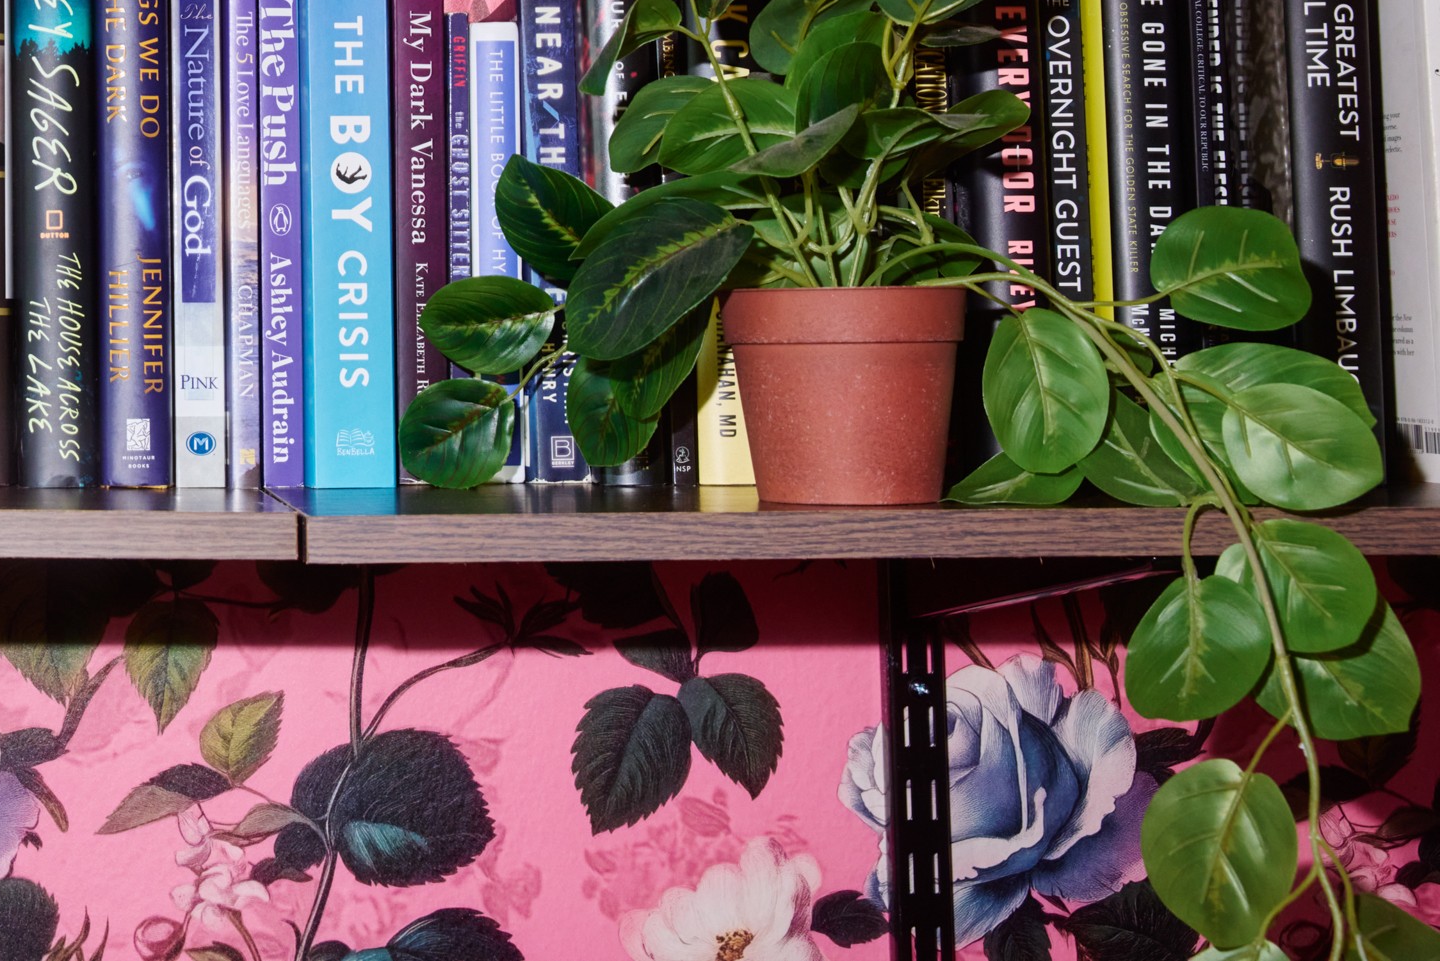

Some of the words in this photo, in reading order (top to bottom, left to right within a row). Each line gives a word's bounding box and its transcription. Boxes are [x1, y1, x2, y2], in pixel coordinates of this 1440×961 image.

[138, 37, 159, 82] WE
[333, 15, 364, 94] THE
[402, 11, 432, 52] My
[535, 7, 564, 100] NEAR
[1141, 23, 1167, 88] GONE
[1305, 23, 1331, 88] TIME
[1334, 3, 1360, 141] GREATEST
[27, 56, 79, 195] SAGER
[105, 44, 127, 123] DARK
[140, 96, 160, 138] DO
[184, 24, 210, 141] Nature
[410, 61, 433, 130] Dark
[1047, 15, 1077, 189] OVERNIGHT
[263, 85, 298, 186] Push
[410, 138, 434, 245] Vanessa
[1329, 187, 1354, 256] RUSH
[1055, 198, 1082, 293] GUEST
[109, 270, 131, 383] HILLIER
[136, 254, 164, 394] JENNIFER
[237, 285, 254, 398] CHAPMAN
[264, 252, 292, 346] Ashley
[337, 250, 370, 388] CRISIS
[180, 374, 218, 390] PINK
[270, 350, 295, 464] Audrain
[719, 415, 737, 438] MD
